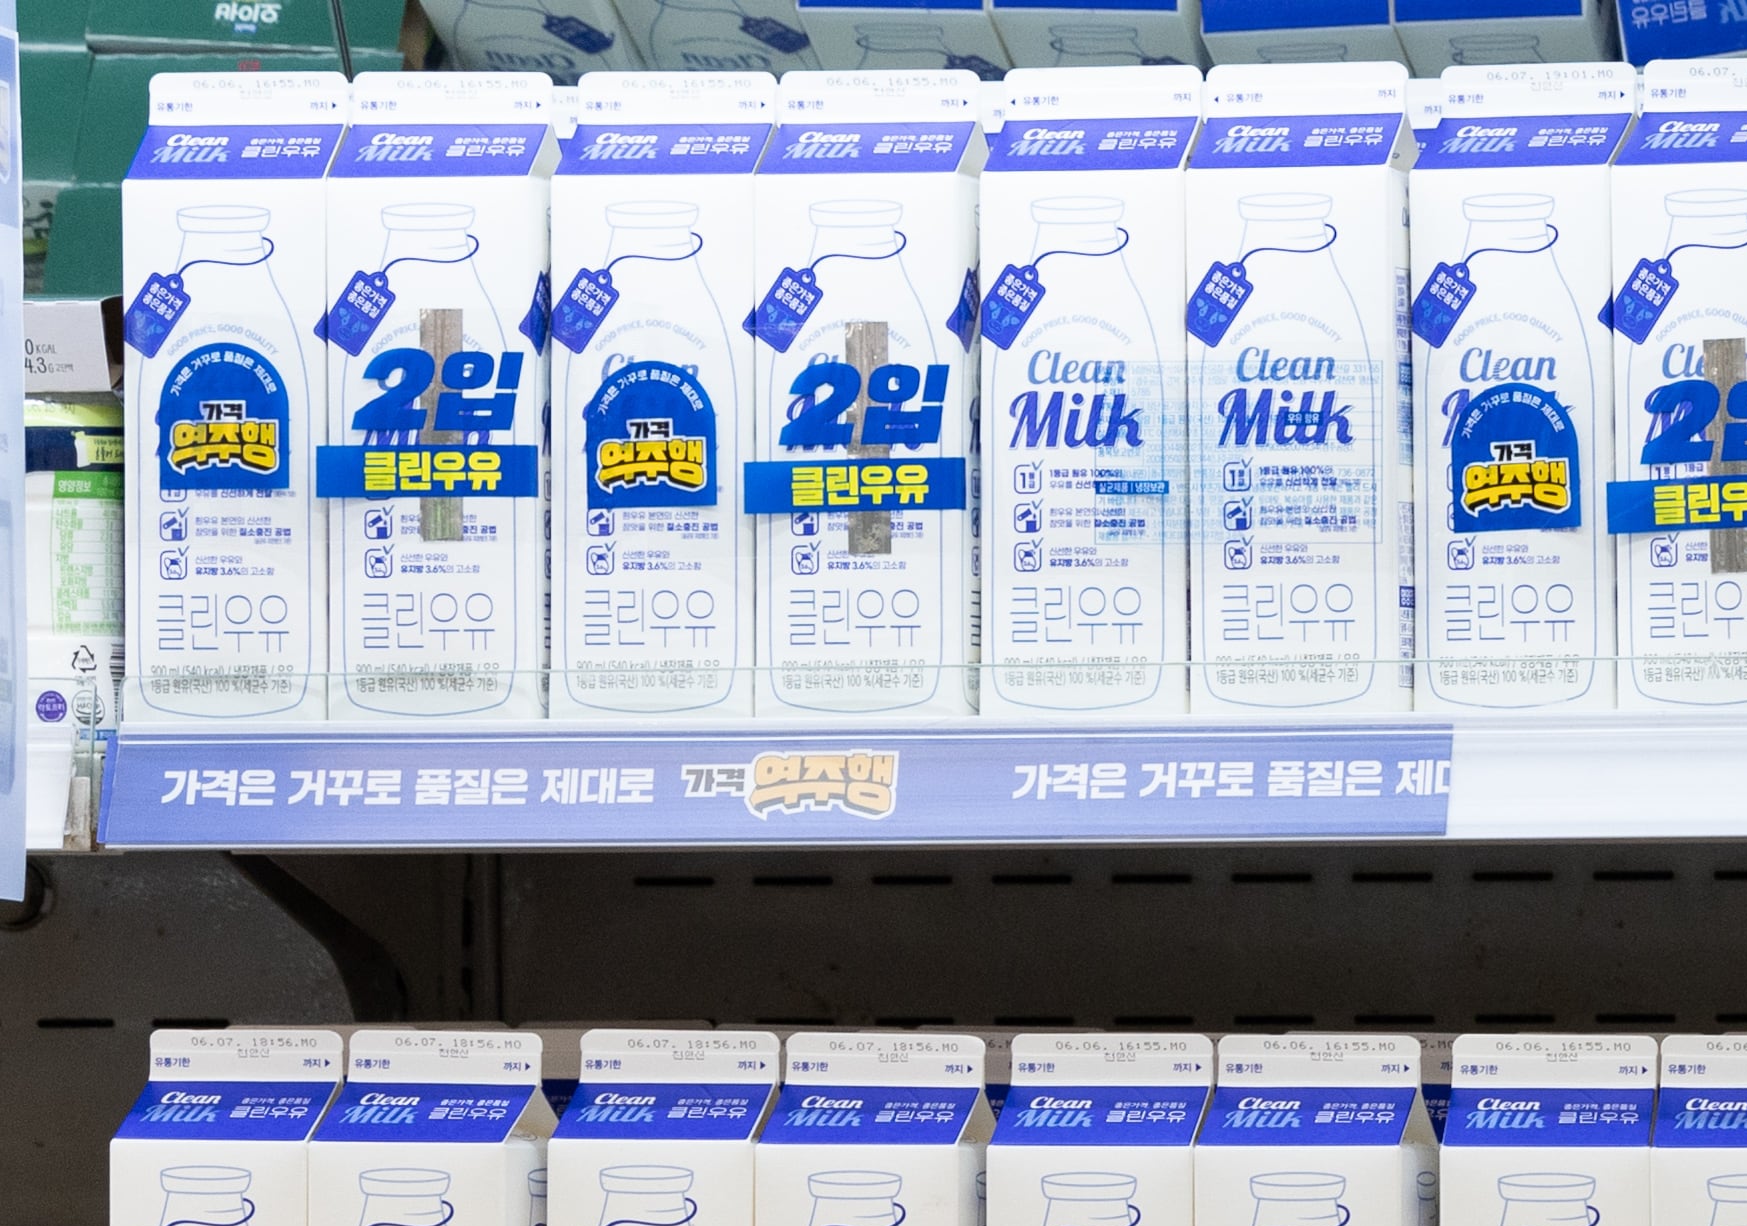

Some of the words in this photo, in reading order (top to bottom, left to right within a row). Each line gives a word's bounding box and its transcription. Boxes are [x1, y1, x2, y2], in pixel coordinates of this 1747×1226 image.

[156, 101, 193, 112] 유통기한
[309, 100, 329, 111] 까지
[150, 145, 230, 164] Milk
[167, 134, 229, 148] Clean
[240, 143, 321, 158] 클린우유
[1027, 349, 1126, 384] Clean
[1237, 347, 1335, 383] Clean
[352, 348, 524, 430] 2입
[203, 403, 243, 420] 가격
[1010, 389, 1143, 448] Milk
[1218, 388, 1354, 447] Milk
[171, 423, 277, 473] 역주행
[1494, 443, 1532, 459] 가격
[364, 451, 502, 492] 클린우유
[1465, 462, 1568, 513] 역주행
[156, 593, 290, 652] 클린우유
[1010, 586, 1143, 645] 클린우유
[161, 769, 274, 806] 가격은
[287, 769, 402, 806] 거꾸로
[415, 768, 528, 806] 품질은
[541, 768, 654, 804] 제대로
[682, 764, 746, 794] 가격
[748, 752, 897, 818] 역주행
[1012, 763, 1126, 799] 가격은
[1140, 762, 1254, 797] 거꾸로
[1267, 761, 1383, 797] 품질은
[155, 1057, 191, 1068] 유통기한
[303, 1058, 321, 1068] 까지
[141, 1104, 220, 1123] Milk
[160, 1090, 222, 1104] Clean
[230, 1105, 309, 1119] 클린우유
